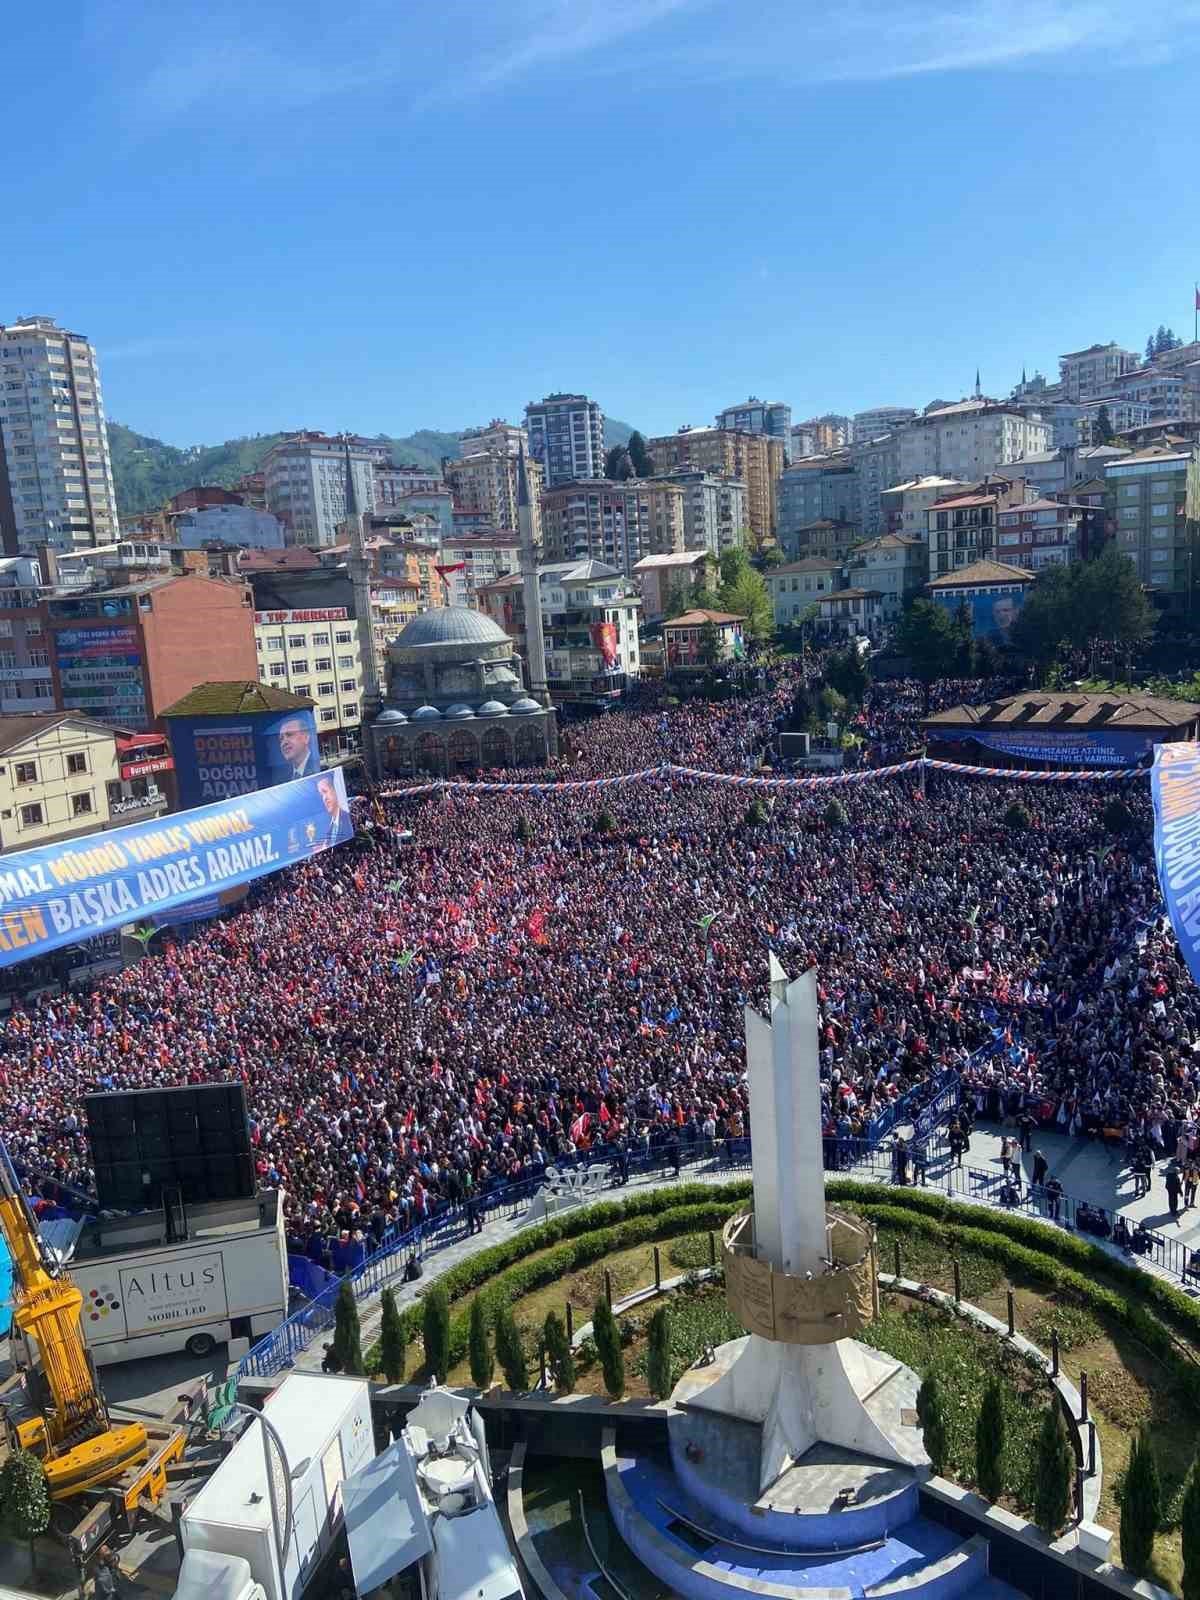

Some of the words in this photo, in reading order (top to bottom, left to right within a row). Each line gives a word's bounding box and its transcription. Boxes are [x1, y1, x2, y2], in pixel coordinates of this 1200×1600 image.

[198, 762, 257, 781] DOĞRU
[201, 779, 259, 798] ADAM
[0, 863, 53, 902] MAZ
[48, 840, 129, 886] MÜHRÜ
[48, 878, 138, 934] BAŞKA
[137, 857, 207, 904] ADRES
[206, 833, 280, 882] ARAMAZ.
[128, 1267, 215, 1298] Altus
